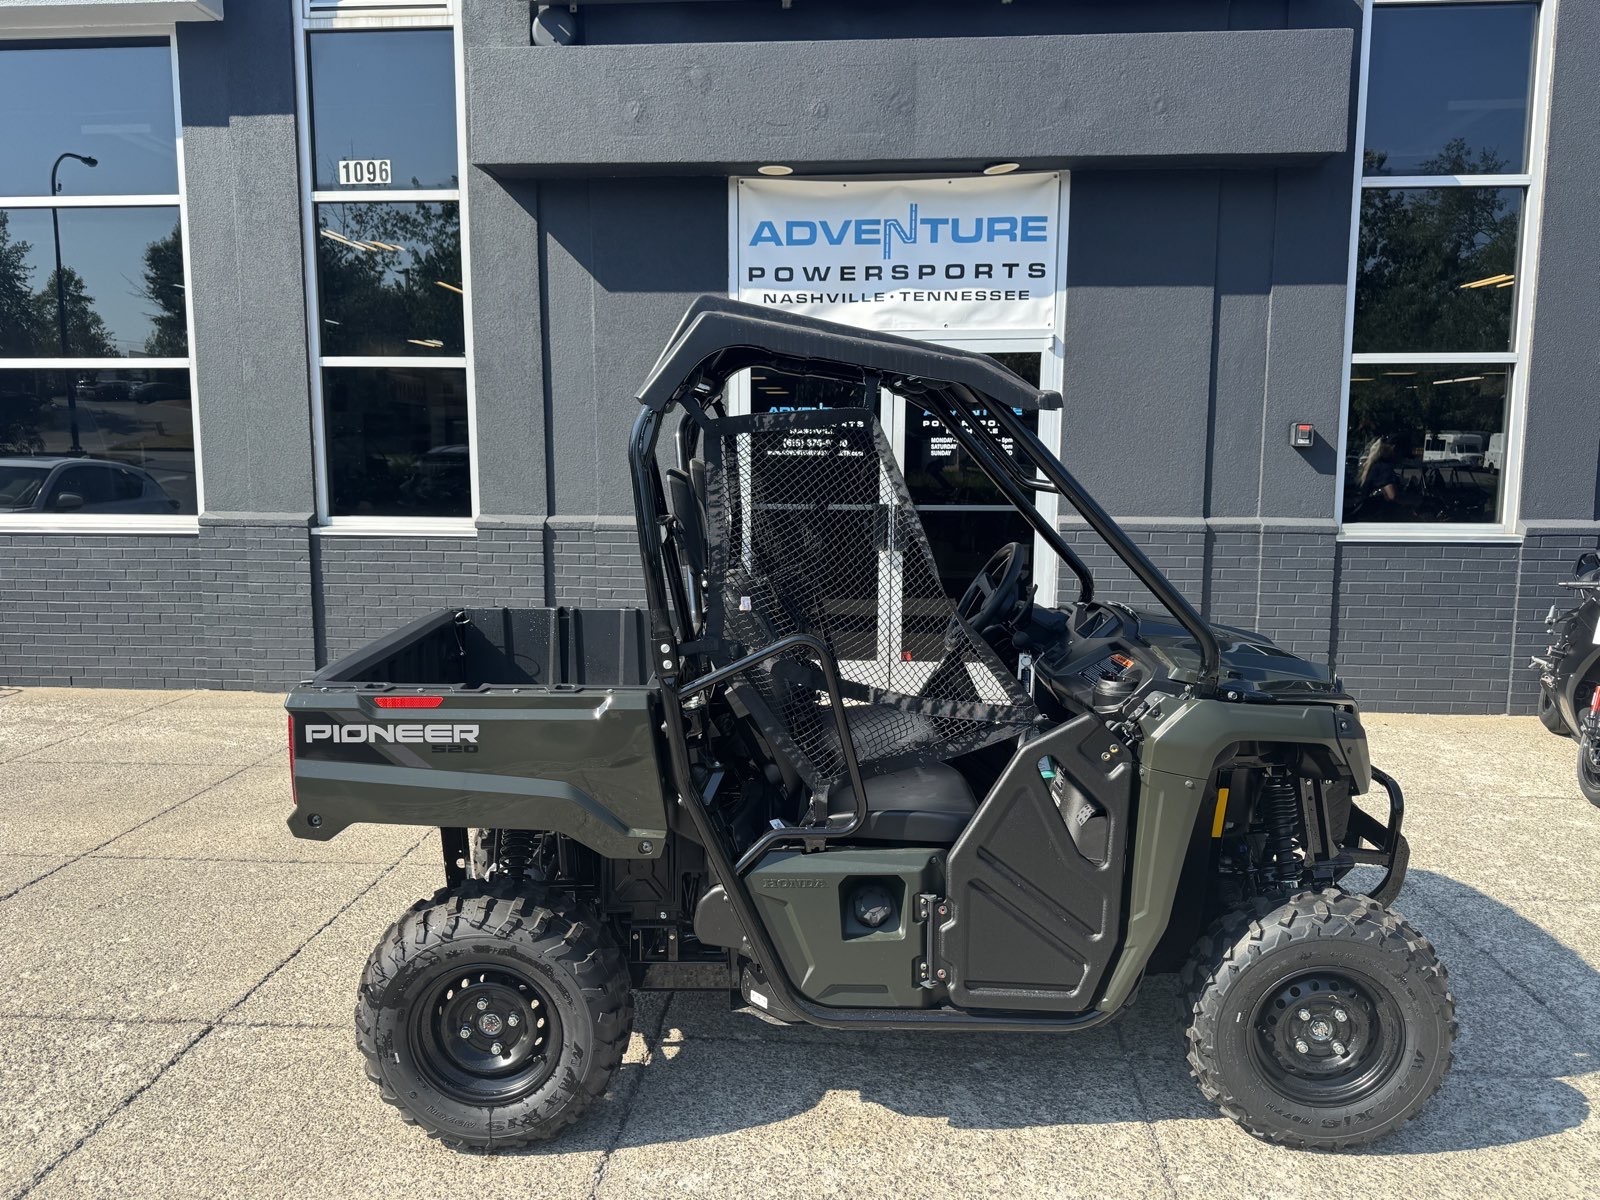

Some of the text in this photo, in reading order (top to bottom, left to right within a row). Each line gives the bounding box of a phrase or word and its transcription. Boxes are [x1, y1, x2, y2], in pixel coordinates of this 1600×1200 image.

[342, 160, 389, 183] 1096
[748, 203, 1049, 260] ADVENTURE
[748, 262, 1047, 283] POWERSPORTS
[763, 290, 1031, 305] NASHVILLE TENNESSEE
[305, 724, 480, 743] PIONEER
[431, 744, 479, 754] 520
[762, 878, 830, 889] HONDA
